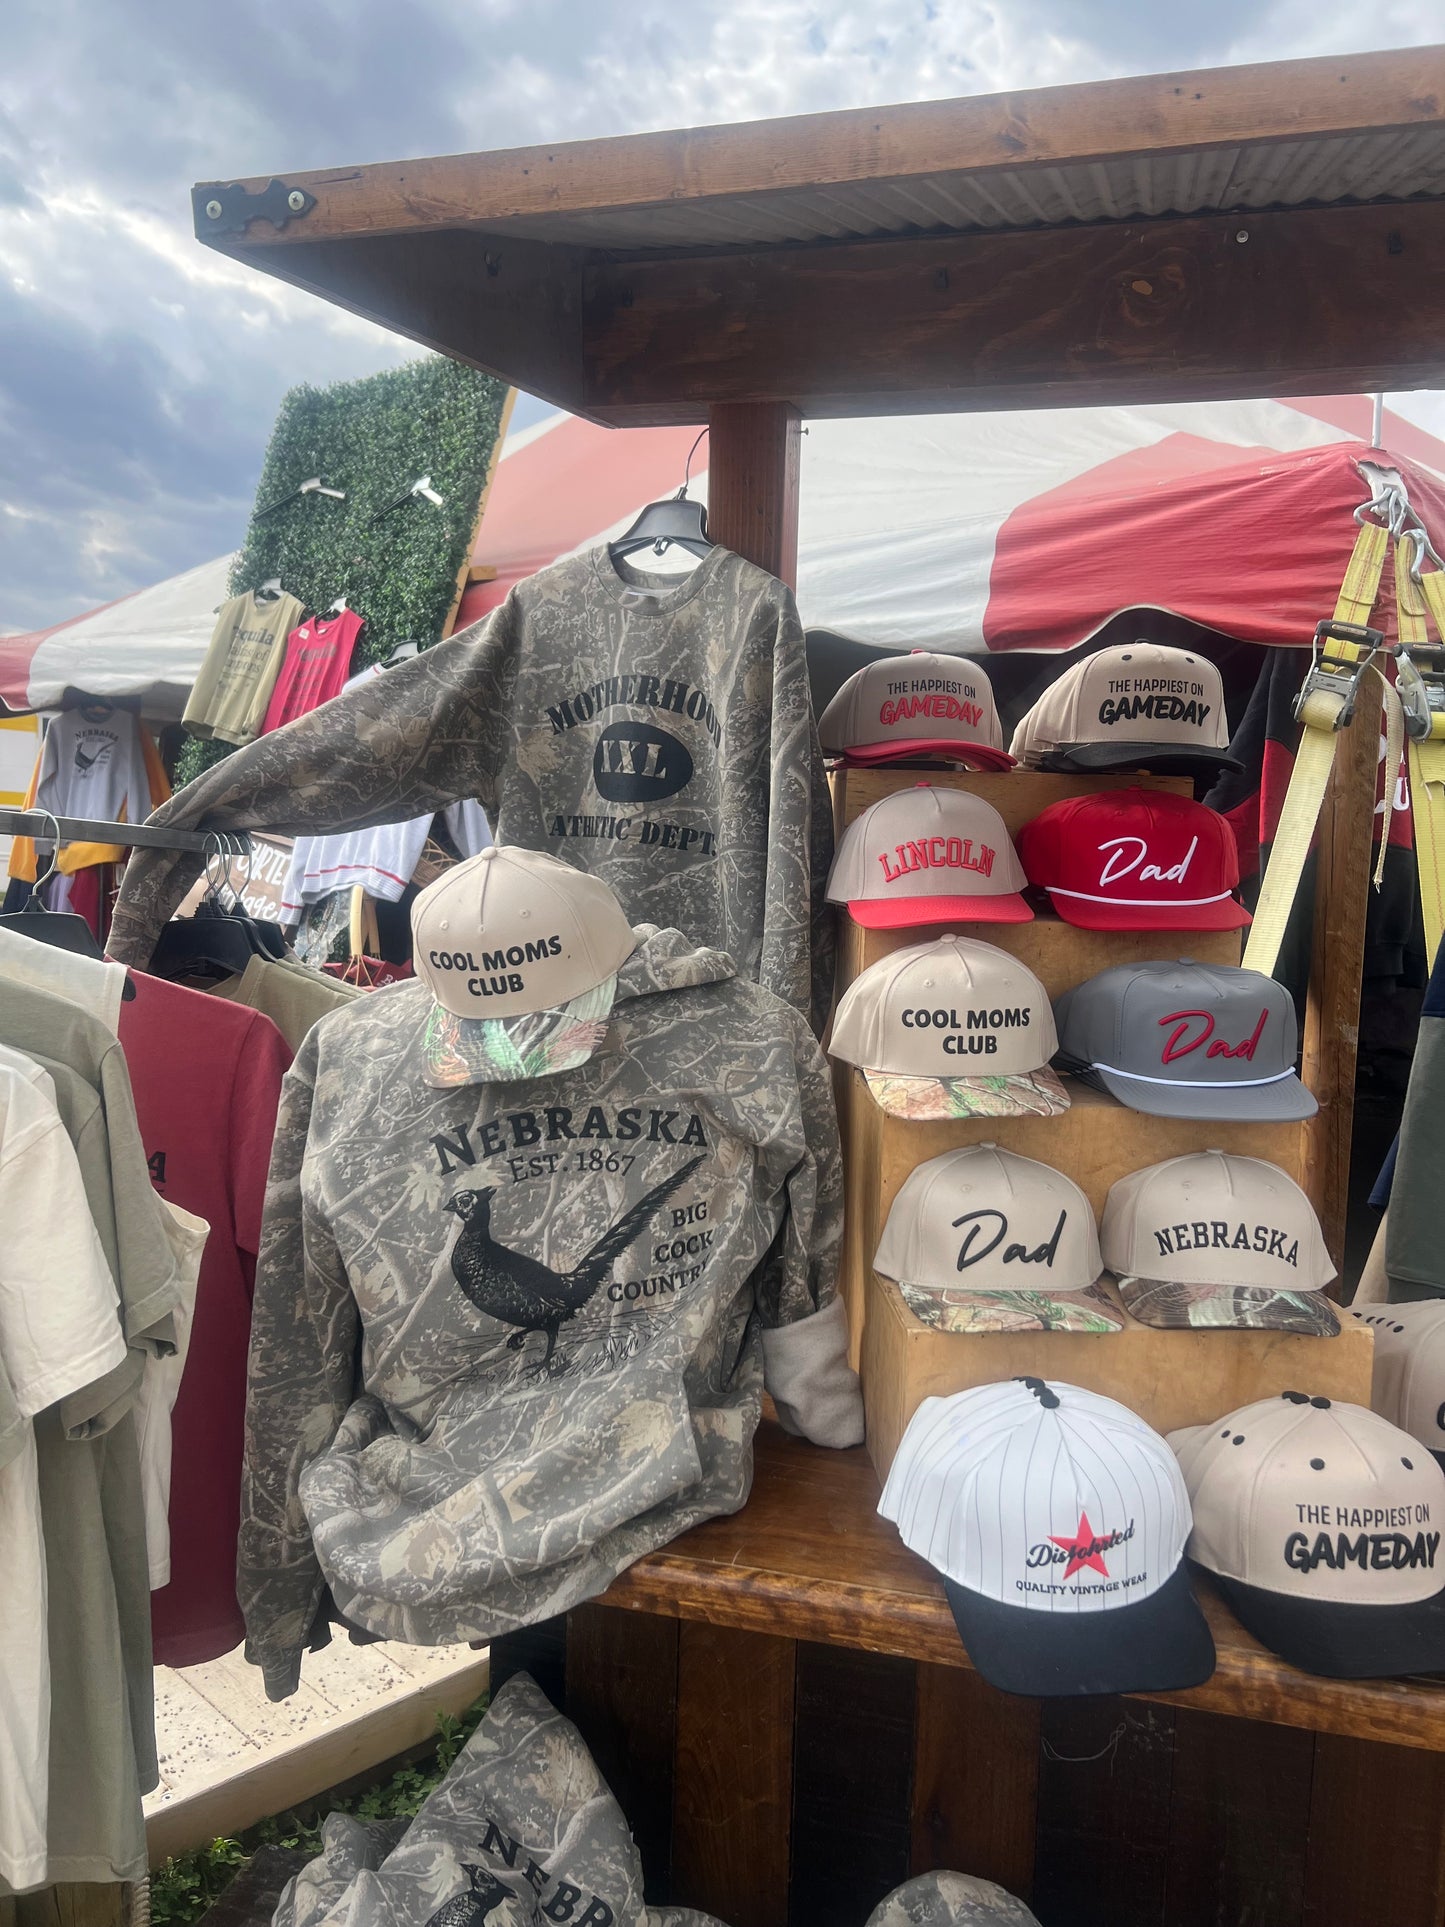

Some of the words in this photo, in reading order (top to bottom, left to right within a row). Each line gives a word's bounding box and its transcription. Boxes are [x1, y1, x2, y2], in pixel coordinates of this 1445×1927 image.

[887, 680, 909, 695] THE
[911, 679, 962, 695] HAPPIEST
[964, 682, 977, 699] ON
[1108, 678, 1131, 693] THE
[1134, 677, 1187, 694] HAPPIEST
[1191, 681, 1205, 697] ON
[879, 695, 984, 727] GAMEDAY
[1099, 695, 1211, 727] GAMEDAY
[639, 820, 717, 857] DEPT.
[877, 836, 996, 883] LINCOLN
[1097, 835, 1199, 887] Dad
[429, 951, 480, 971] COOL
[481, 935, 562, 971] MOMS
[468, 973, 524, 997] CLUB
[901, 1008, 962, 1029] COOL
[966, 1007, 1031, 1029] MOMS
[942, 1033, 998, 1055] CLUB
[1158, 1008, 1270, 1064] Dad
[429, 1106, 708, 1176] NEBRASKA
[506, 1153, 569, 1183] EST.
[576, 1149, 636, 1177] 1867
[671, 1202, 707, 1228] BIG
[655, 1229, 714, 1264] COCK
[951, 1209, 1068, 1273] Dad
[1153, 1220, 1301, 1268] NEBRASKA
[1296, 1504, 1331, 1525] THE
[1336, 1506, 1412, 1528] HAPPIEST
[1415, 1503, 1430, 1523] ON
[1284, 1531, 1441, 1574] GAMEDAY
[1016, 1580, 1067, 1595] QUALITY
[1069, 1581, 1120, 1595] VINTAGE
